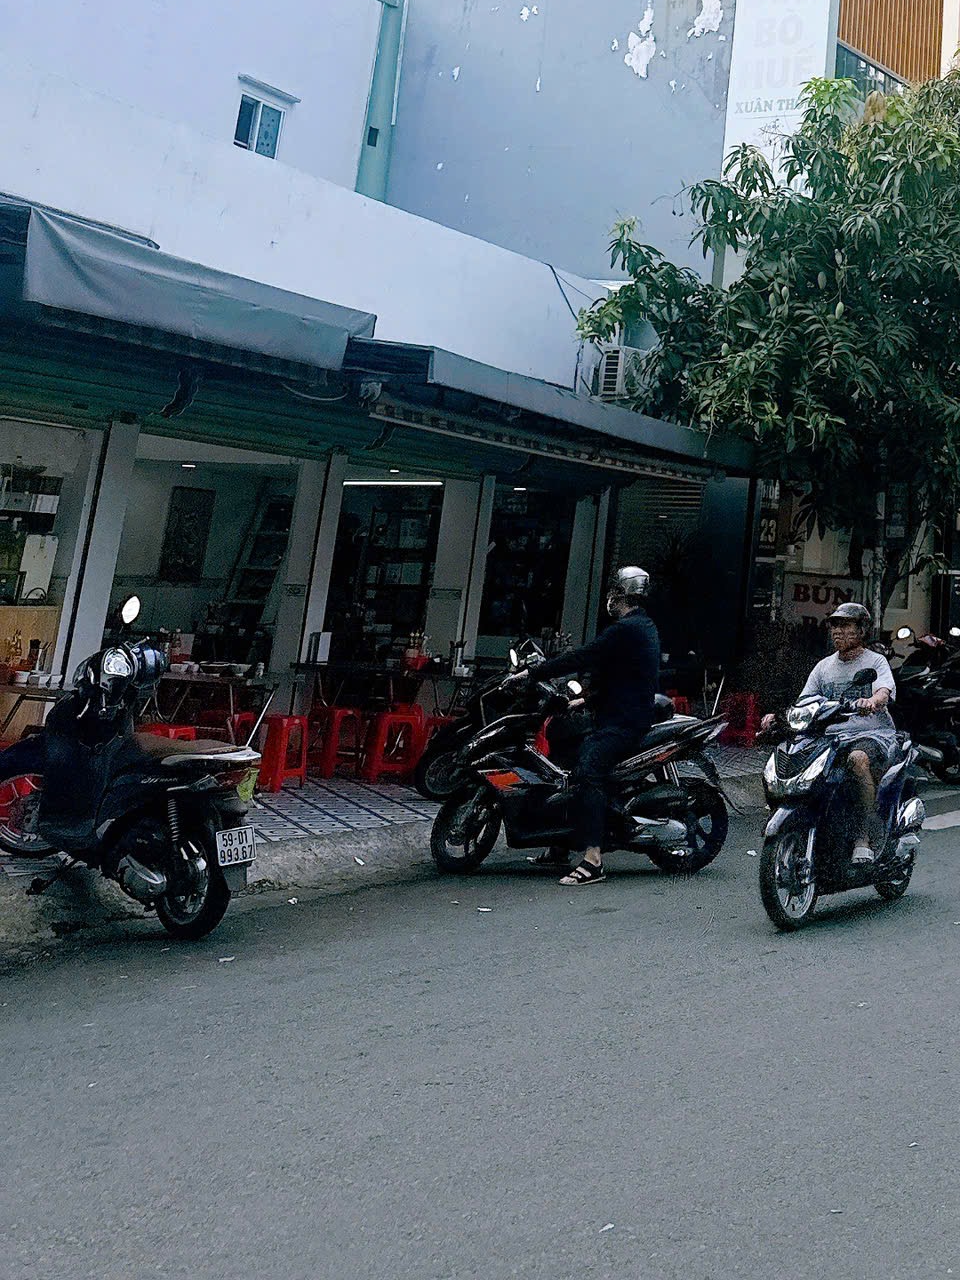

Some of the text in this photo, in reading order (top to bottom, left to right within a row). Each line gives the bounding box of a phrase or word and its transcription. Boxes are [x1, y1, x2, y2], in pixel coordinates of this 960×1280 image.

[735, 97, 773, 114] XUÂN
[760, 518, 777, 543] 23
[221, 830, 248, 847] 59-D1
[220, 844, 253, 864] 993.67
